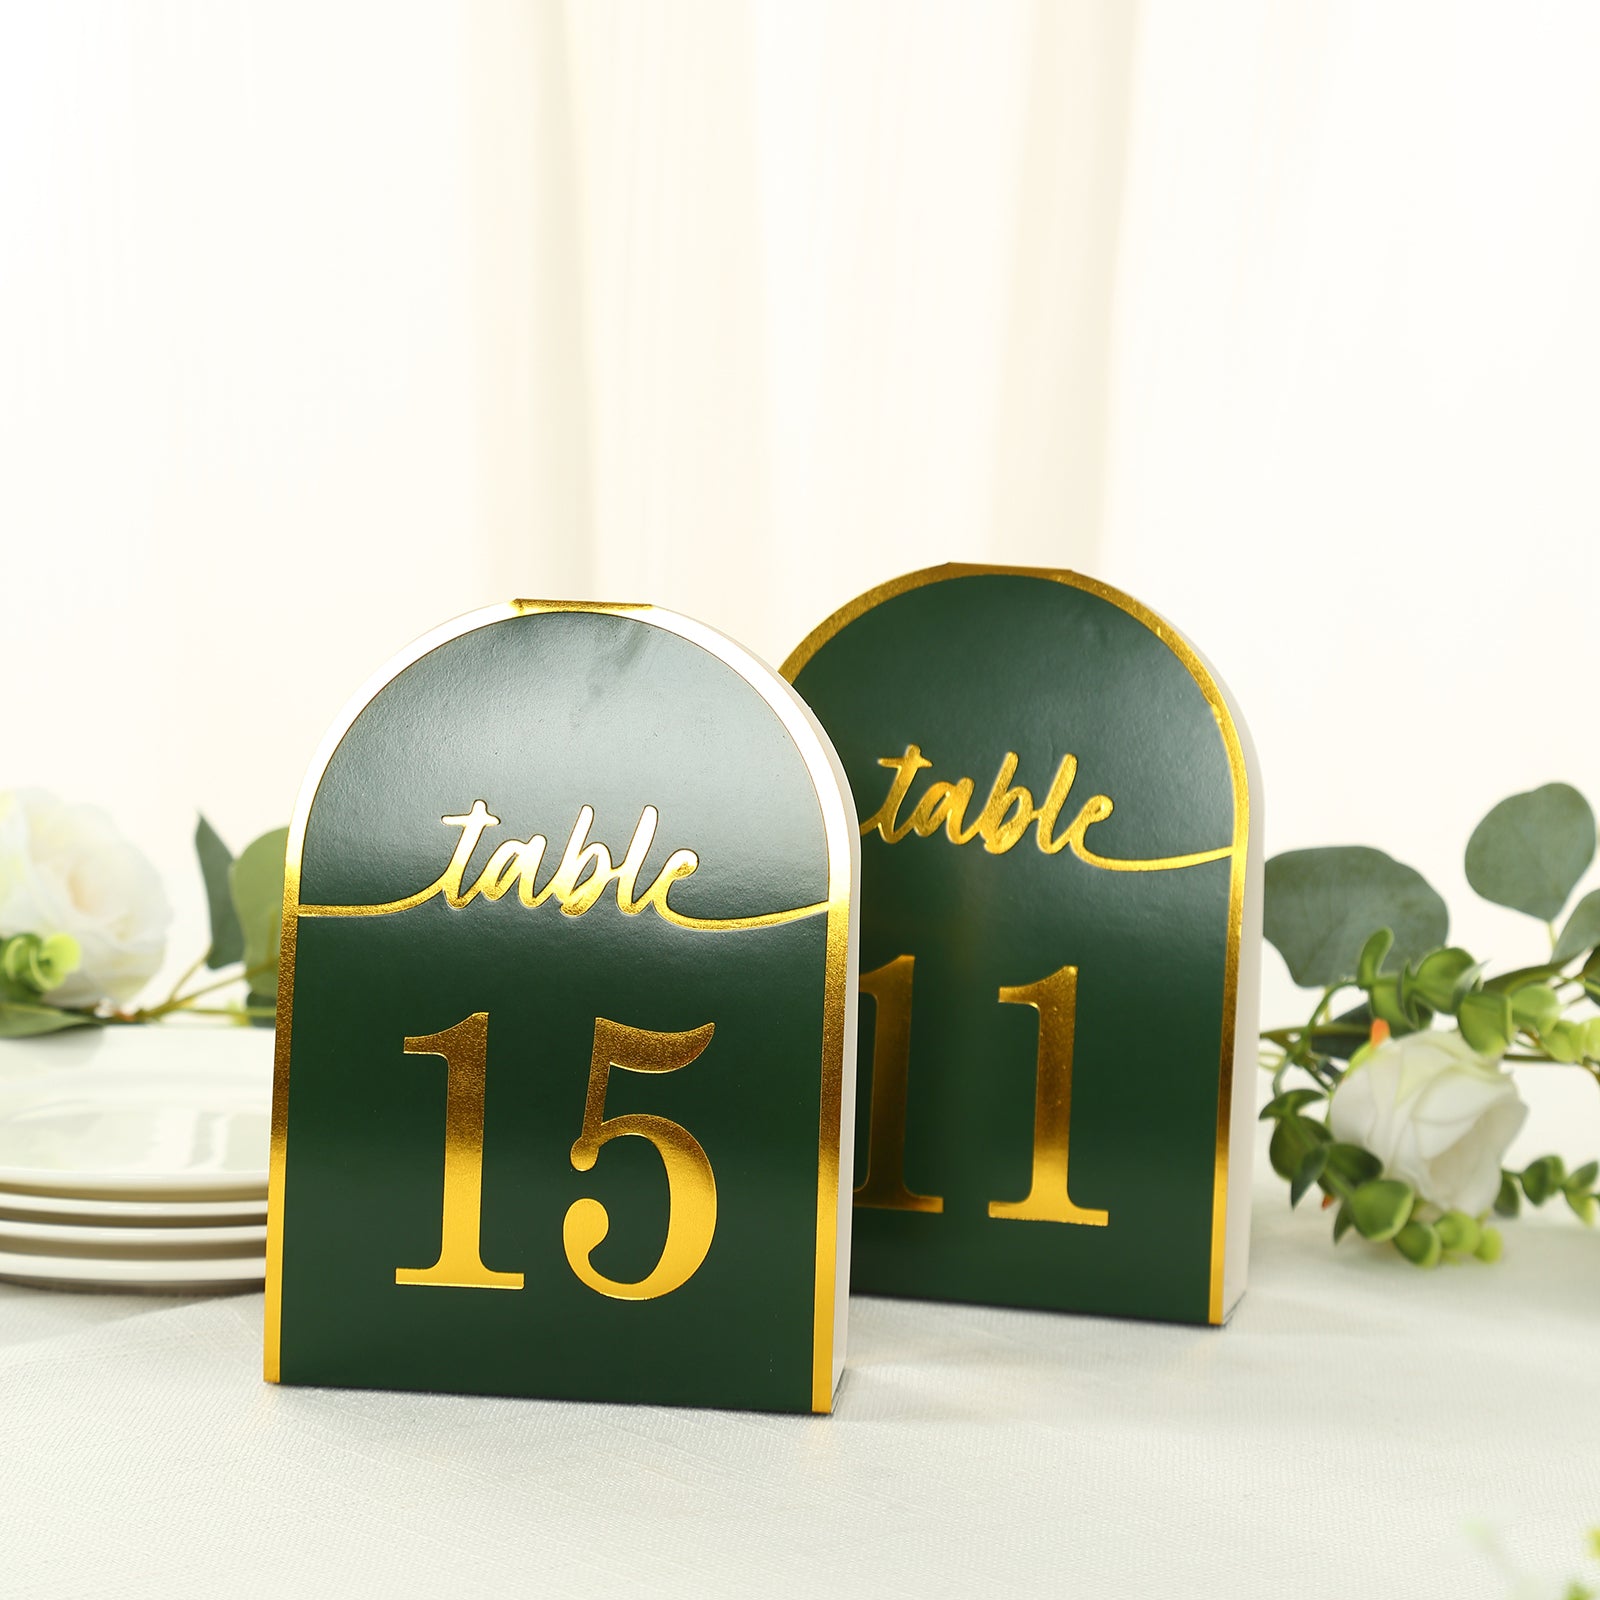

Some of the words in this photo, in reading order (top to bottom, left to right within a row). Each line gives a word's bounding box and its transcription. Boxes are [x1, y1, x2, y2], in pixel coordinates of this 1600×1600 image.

[432, 799, 702, 931] table
[863, 743, 1116, 871] table
[394, 1011, 718, 1301] 15
[853, 954, 1109, 1227] 11
